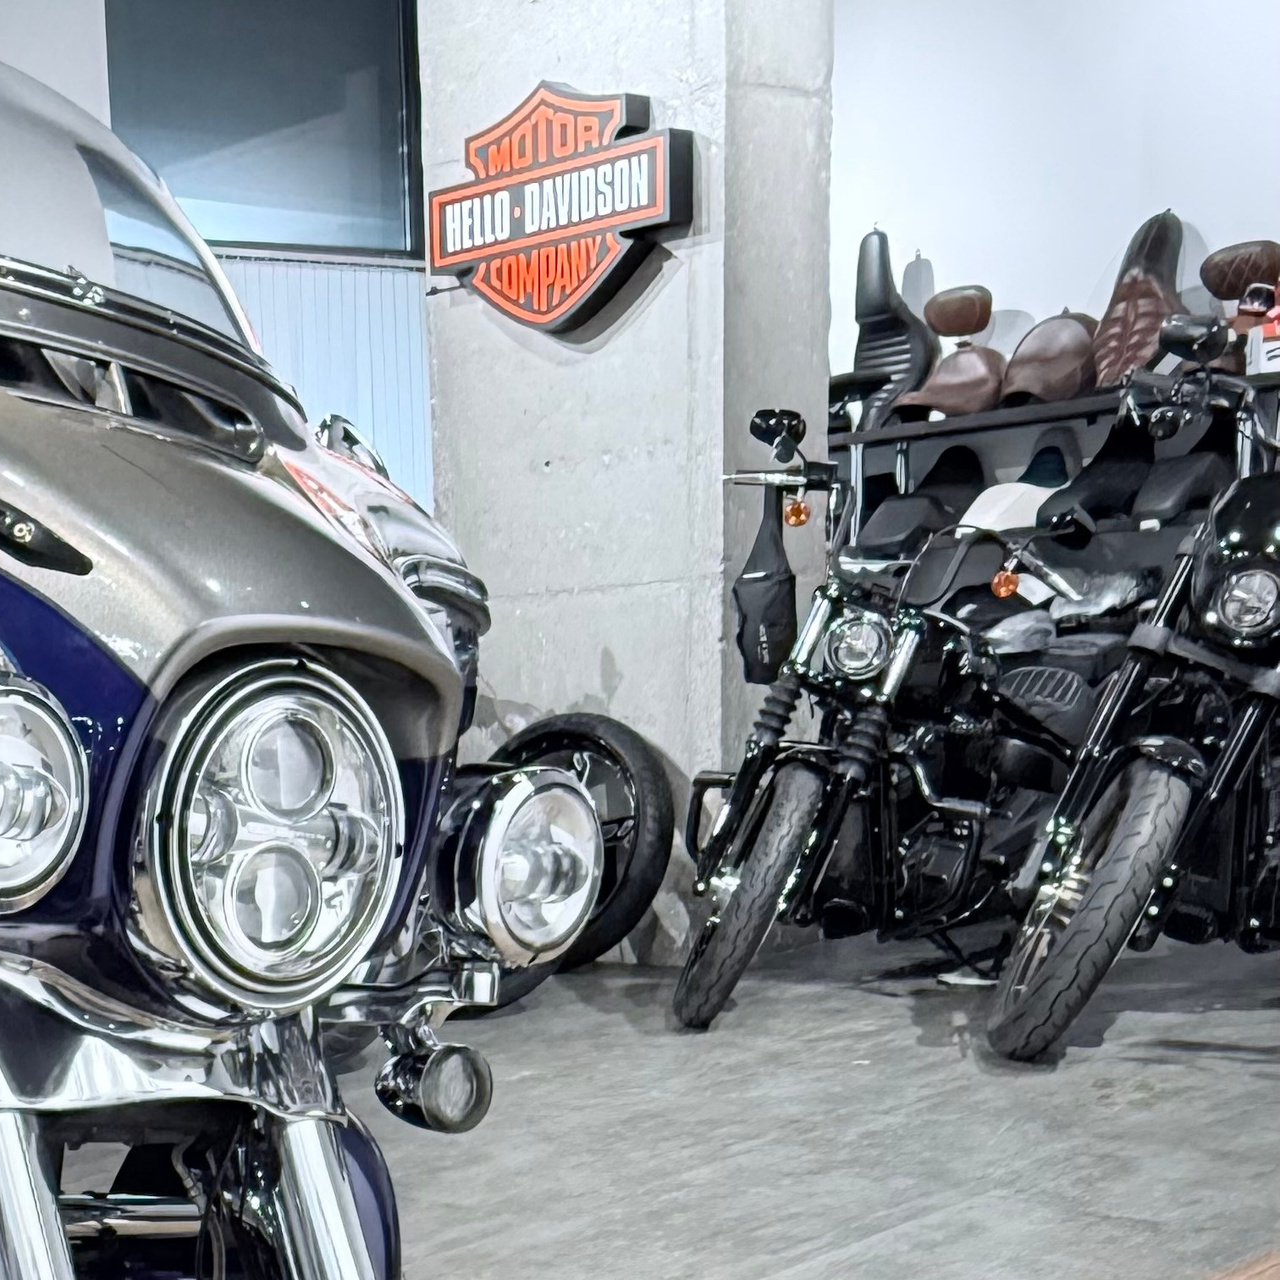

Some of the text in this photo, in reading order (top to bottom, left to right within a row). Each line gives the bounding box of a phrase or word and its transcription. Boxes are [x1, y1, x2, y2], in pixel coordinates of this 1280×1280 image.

[487, 104, 600, 176] MOTOR
[445, 153, 649, 253] HELLO DAVIDSON
[489, 234, 603, 312] COMPANY
